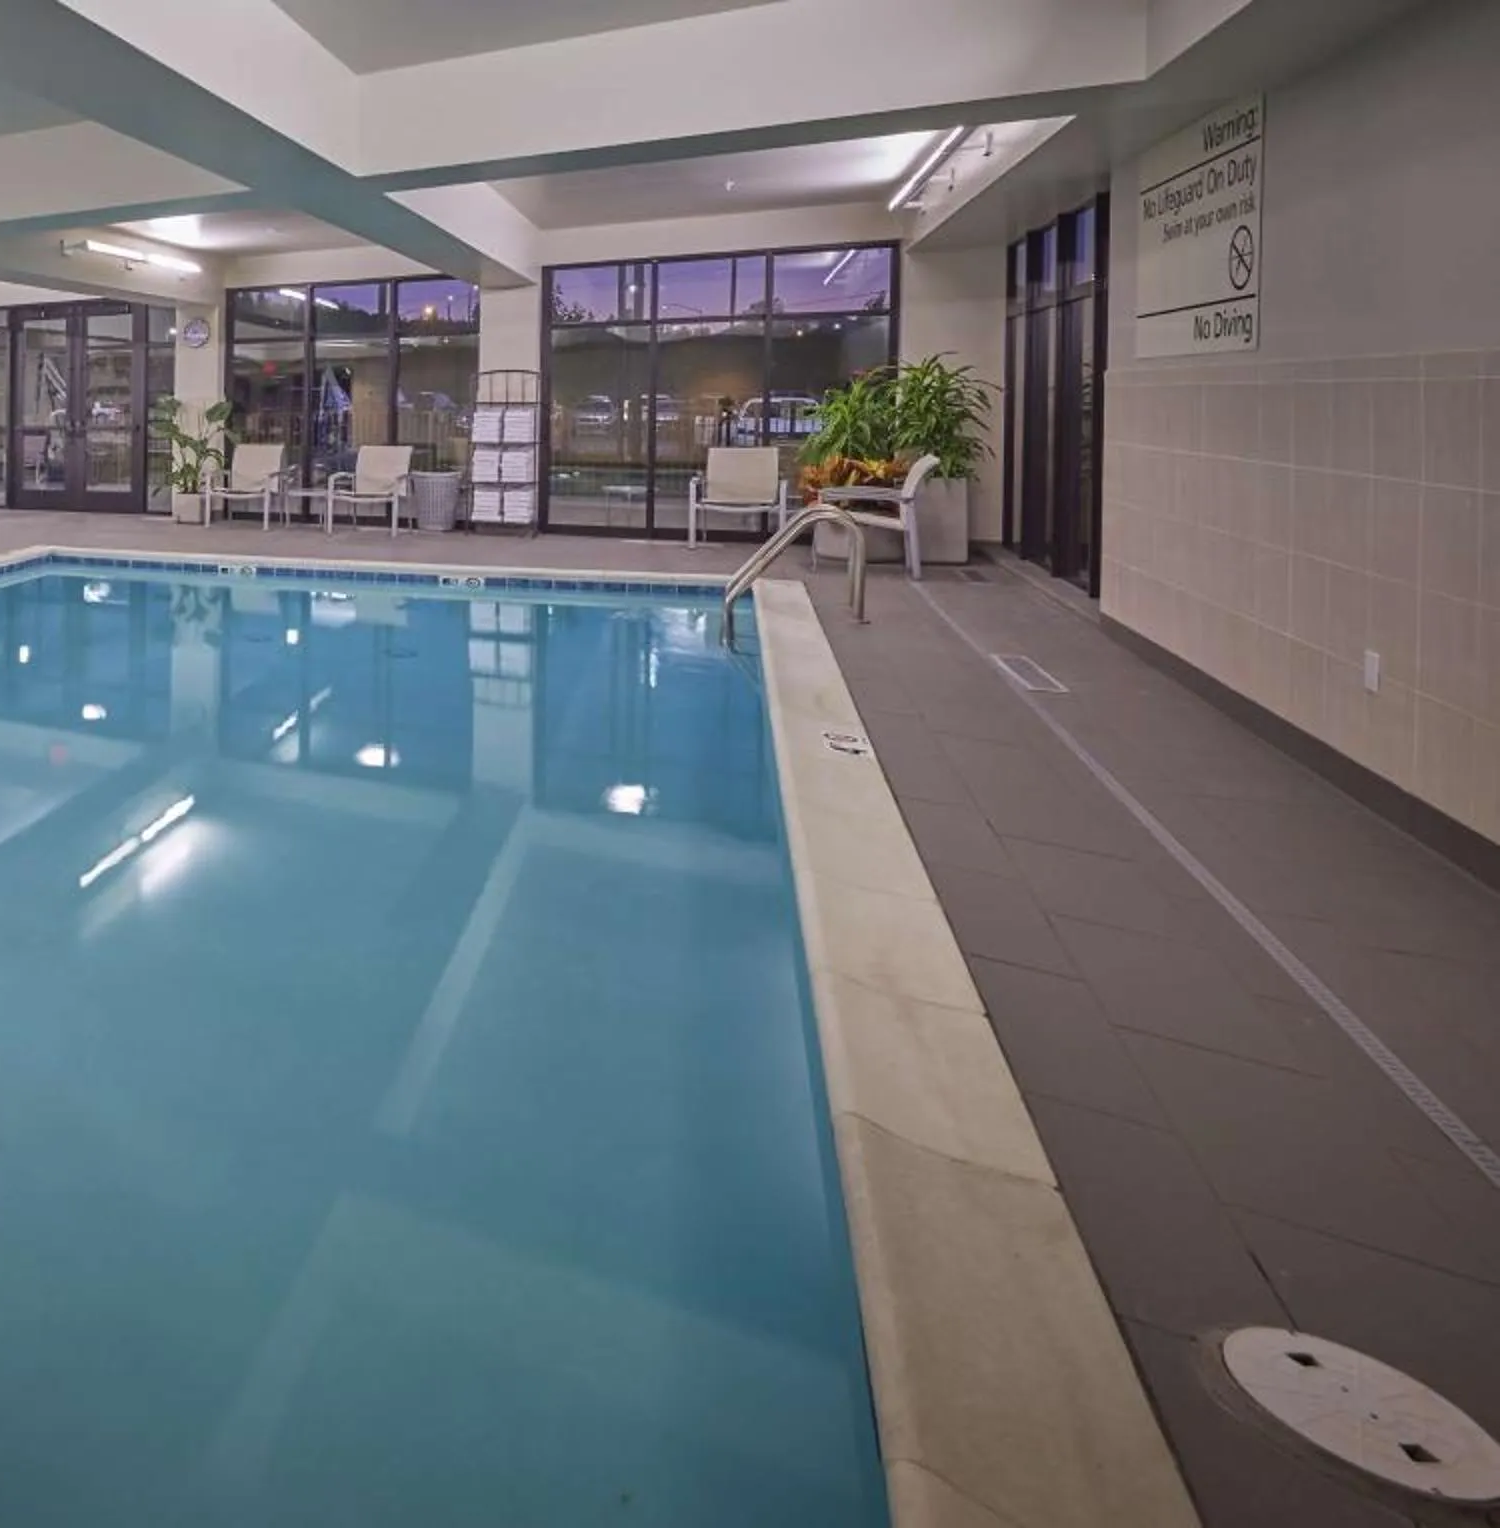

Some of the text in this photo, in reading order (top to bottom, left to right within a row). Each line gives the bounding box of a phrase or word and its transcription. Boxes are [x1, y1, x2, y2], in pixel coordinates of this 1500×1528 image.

[1143, 198, 1156, 221] No
[1207, 168, 1225, 194] On
[1228, 154, 1257, 187] Duty
[1184, 216, 1193, 235] at
[1193, 306, 1253, 344] No Diving
